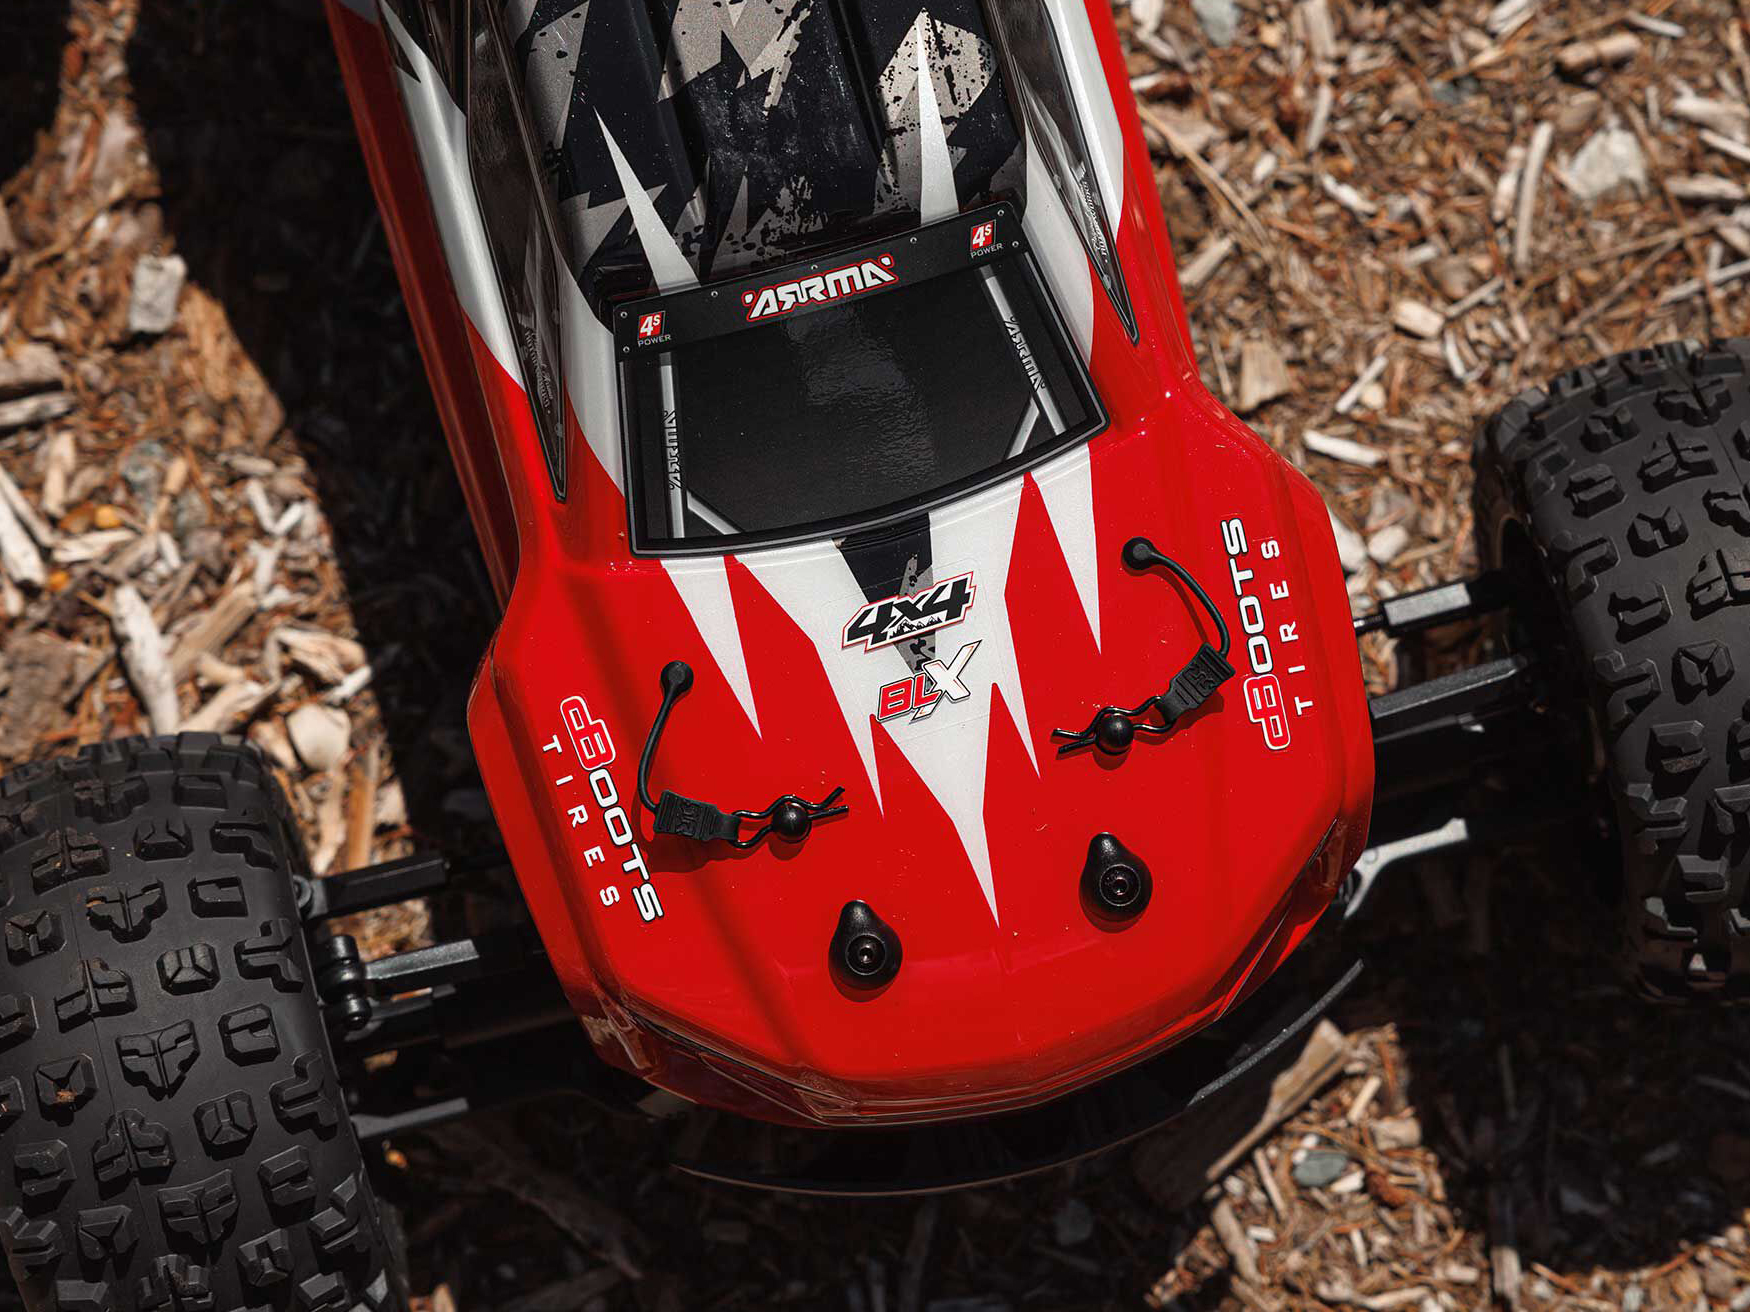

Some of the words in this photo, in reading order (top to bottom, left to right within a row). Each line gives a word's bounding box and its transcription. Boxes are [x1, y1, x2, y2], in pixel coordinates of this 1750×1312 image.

[970, 242, 1004, 259] POWER
[637, 334, 671, 348] POWER
[1260, 539, 1313, 716] TIRES
[877, 639, 983, 725] BLX
[542, 734, 620, 907] TIRES
